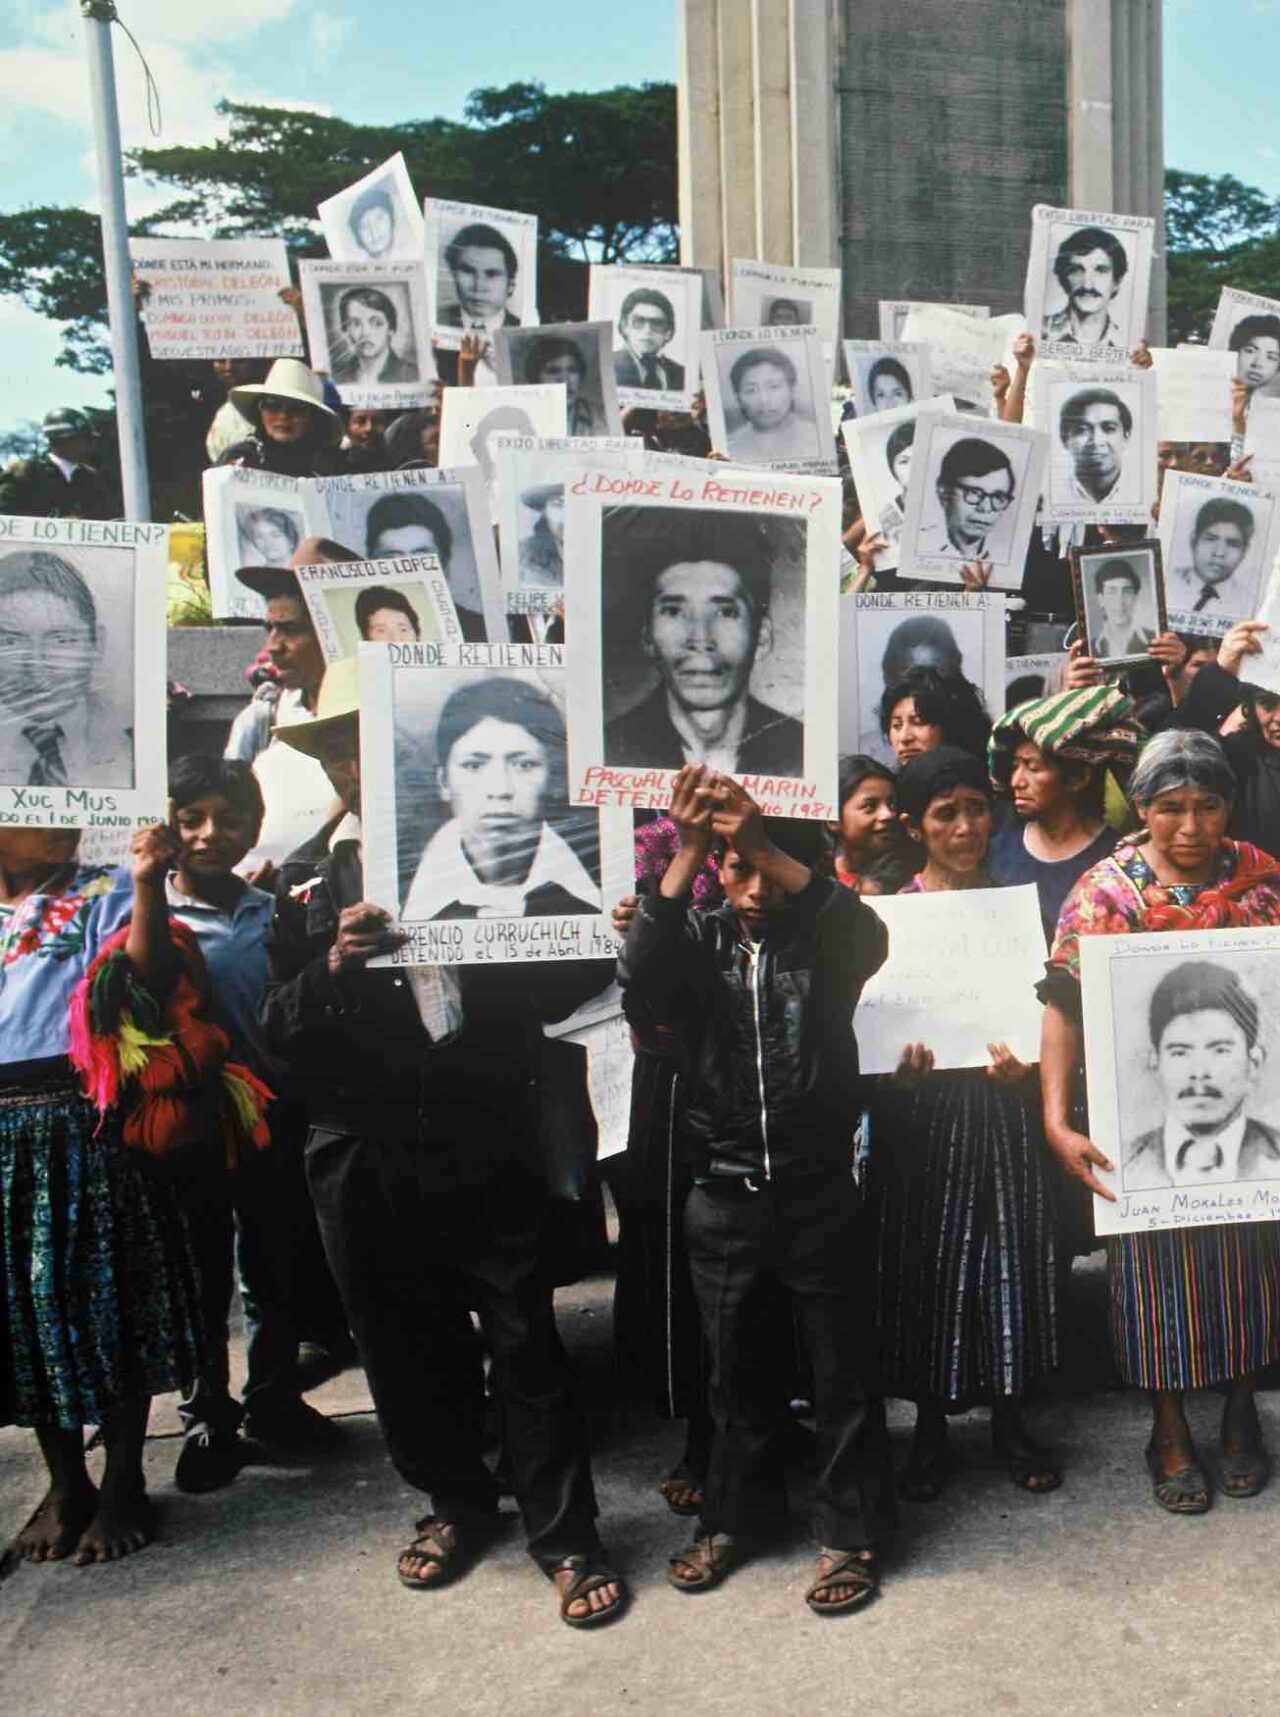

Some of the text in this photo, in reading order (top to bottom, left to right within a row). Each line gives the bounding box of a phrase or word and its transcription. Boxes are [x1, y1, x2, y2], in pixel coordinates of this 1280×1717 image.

[855, 593, 897, 608] DONDE
[387, 643, 563, 667] DONDE RETIENEN
